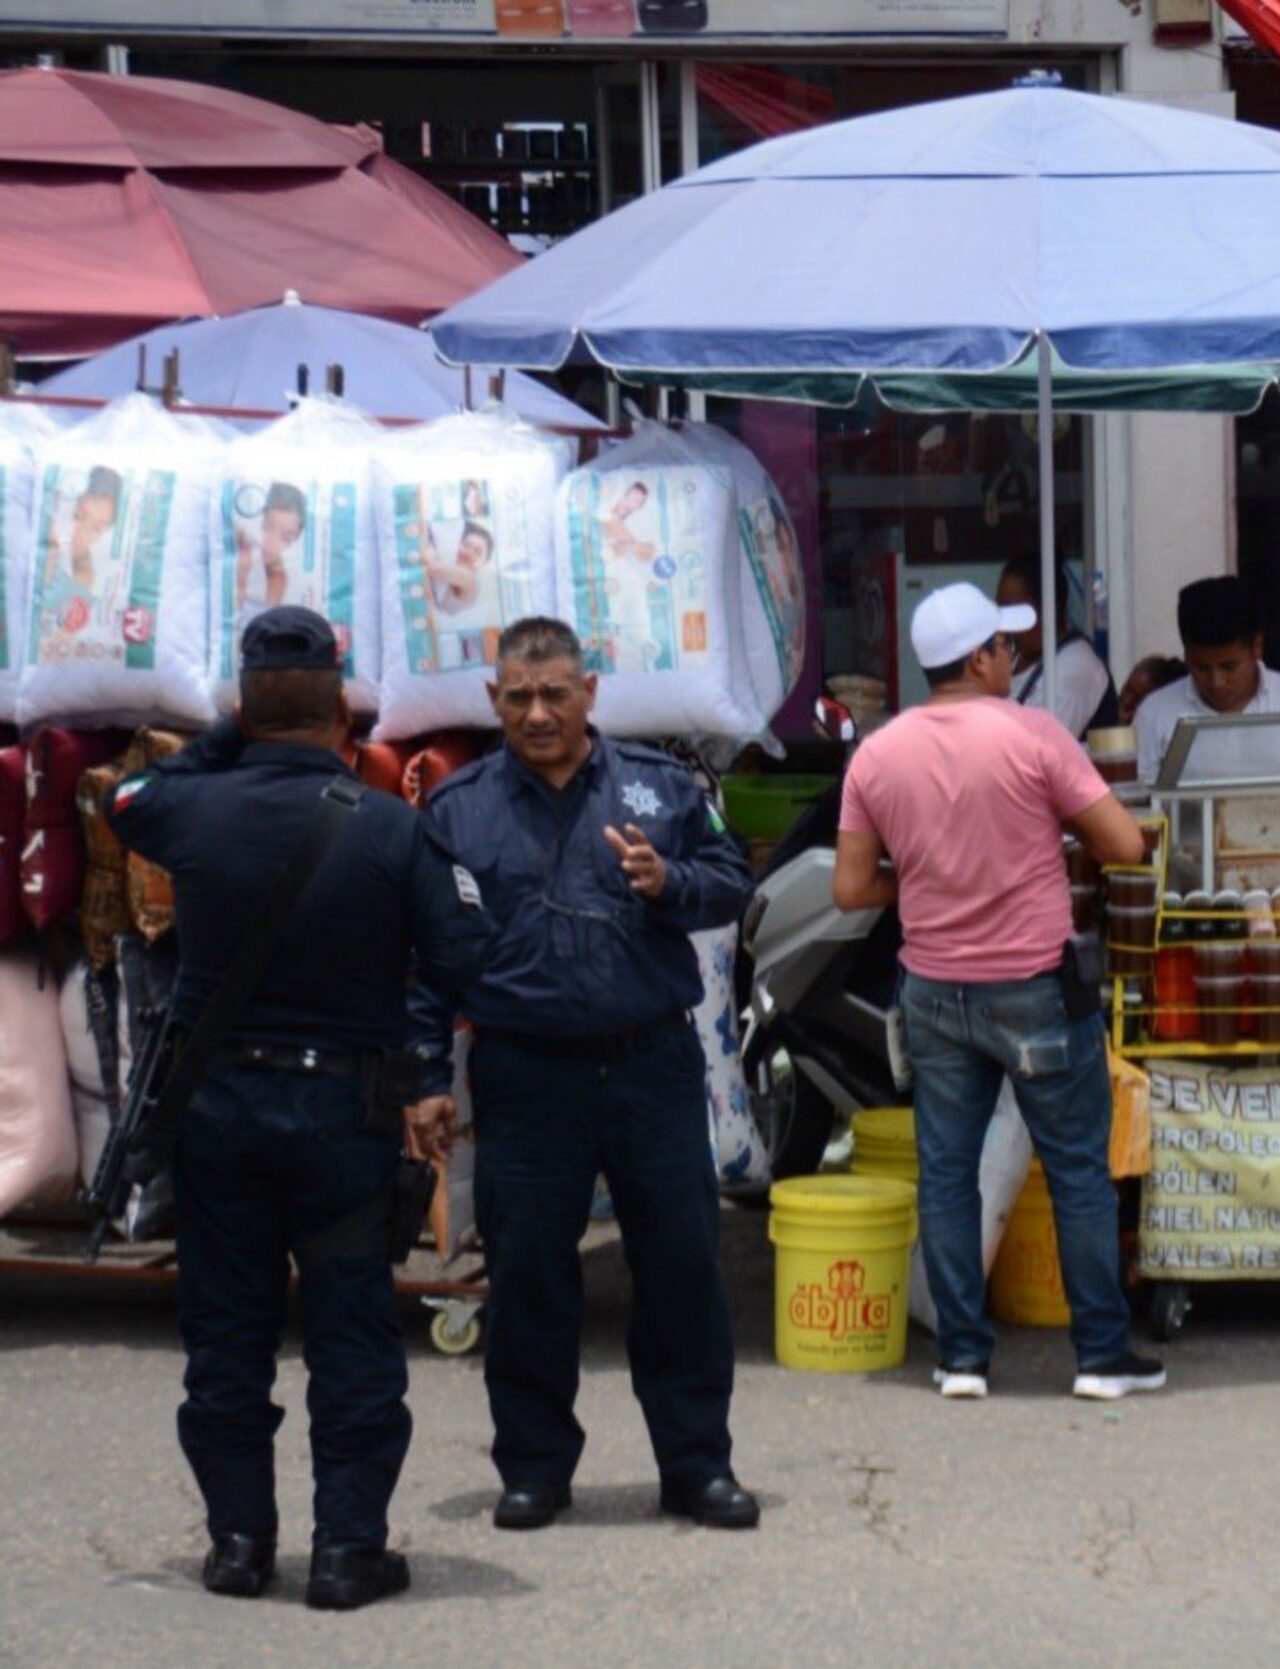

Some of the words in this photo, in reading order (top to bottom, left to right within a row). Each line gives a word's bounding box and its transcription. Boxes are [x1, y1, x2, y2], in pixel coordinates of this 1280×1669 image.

[1151, 1072, 1203, 1113] SE
[1147, 1205, 1208, 1231] MIEL
[1144, 1243, 1234, 1269] JALEA
